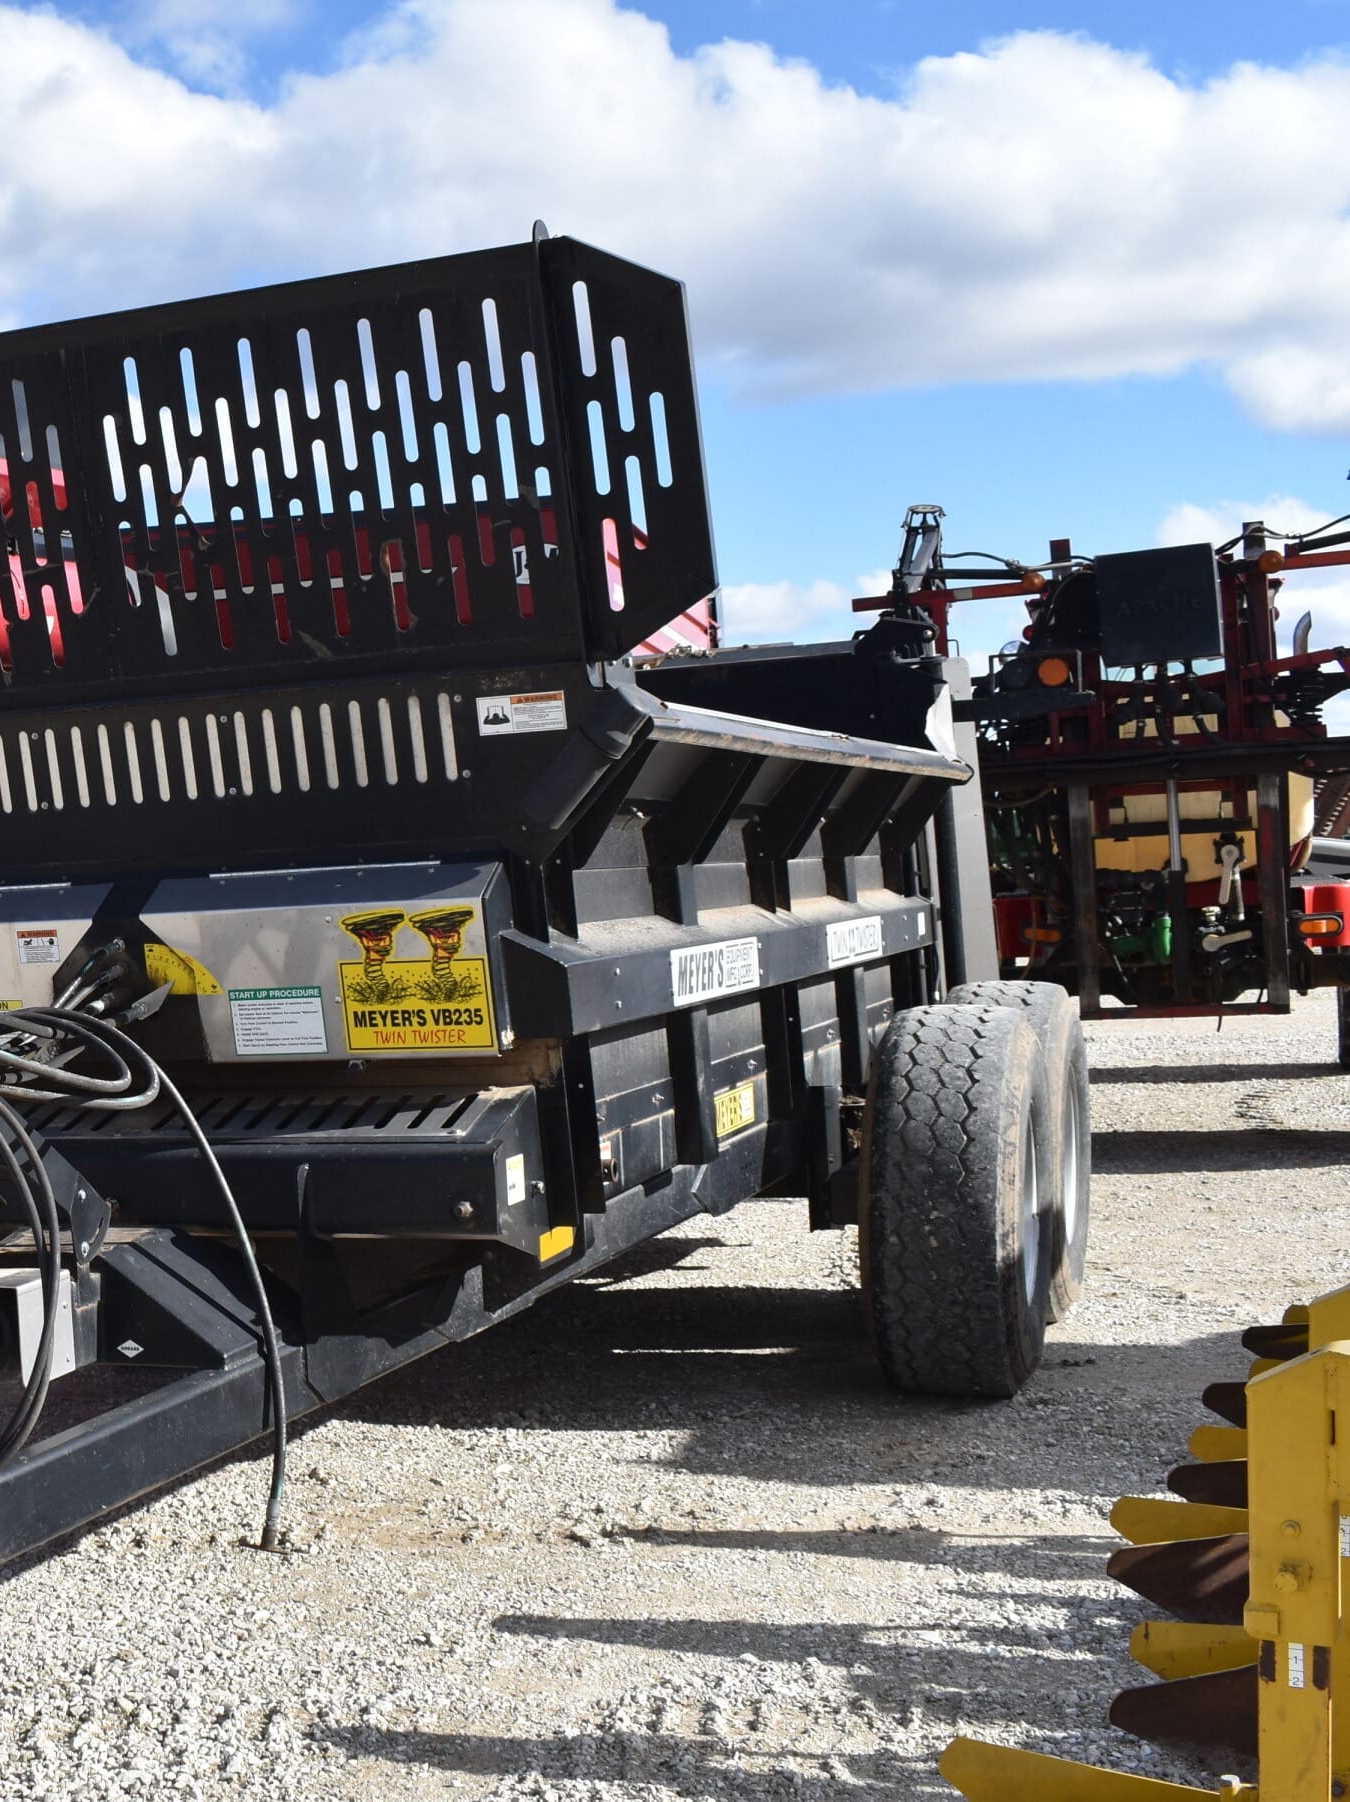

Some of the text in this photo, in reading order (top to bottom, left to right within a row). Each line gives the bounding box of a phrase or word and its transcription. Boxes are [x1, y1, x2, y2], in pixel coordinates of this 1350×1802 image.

[1116, 597, 1203, 617] APACHE
[524, 694, 557, 702] WARNING
[678, 948, 724, 997] MEYER'S
[230, 988, 320, 999] START UP PROCEDURE
[353, 1008, 484, 1028] MEYER'S VB235
[373, 1029, 466, 1045] TWIN TWISTER
[1292, 1676, 1300, 1686] 2
